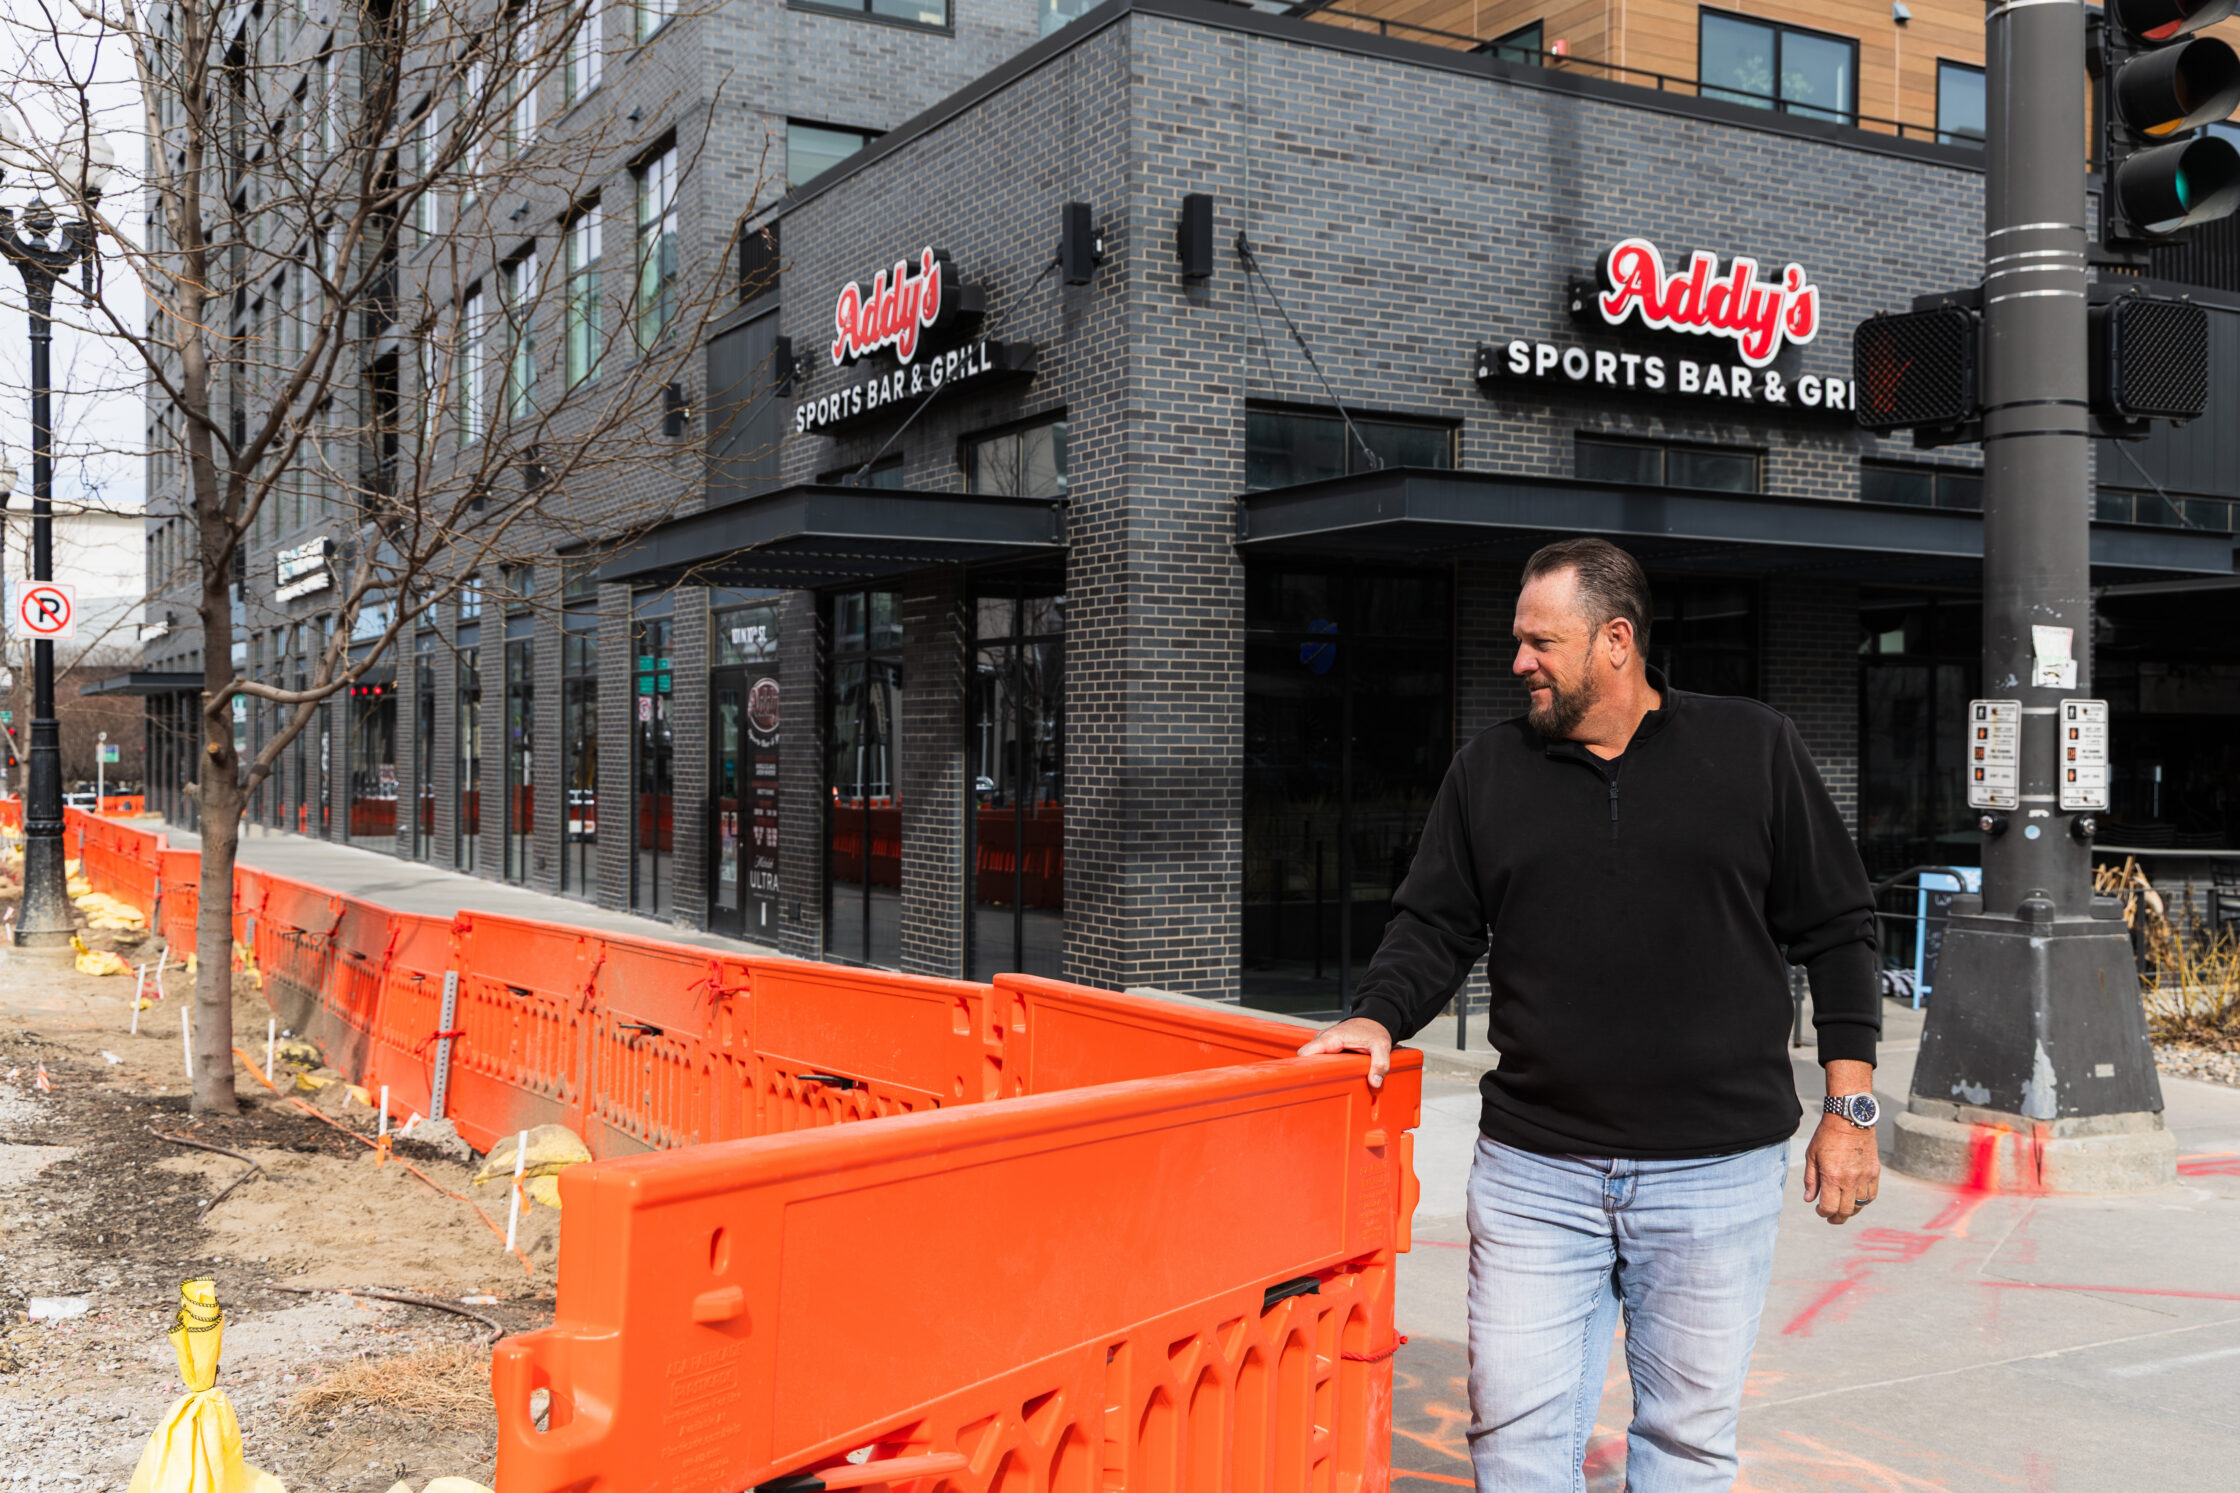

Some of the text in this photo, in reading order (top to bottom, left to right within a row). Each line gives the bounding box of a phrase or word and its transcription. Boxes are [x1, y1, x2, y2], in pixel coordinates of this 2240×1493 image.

[831, 246, 941, 366] Addy's
[1599, 238, 1820, 367] Addy's
[796, 341, 992, 433] SPORTS BAR & GRILL
[1508, 340, 1856, 411] SPORTS BAR & GRI
[750, 869, 780, 892] ULTRA
